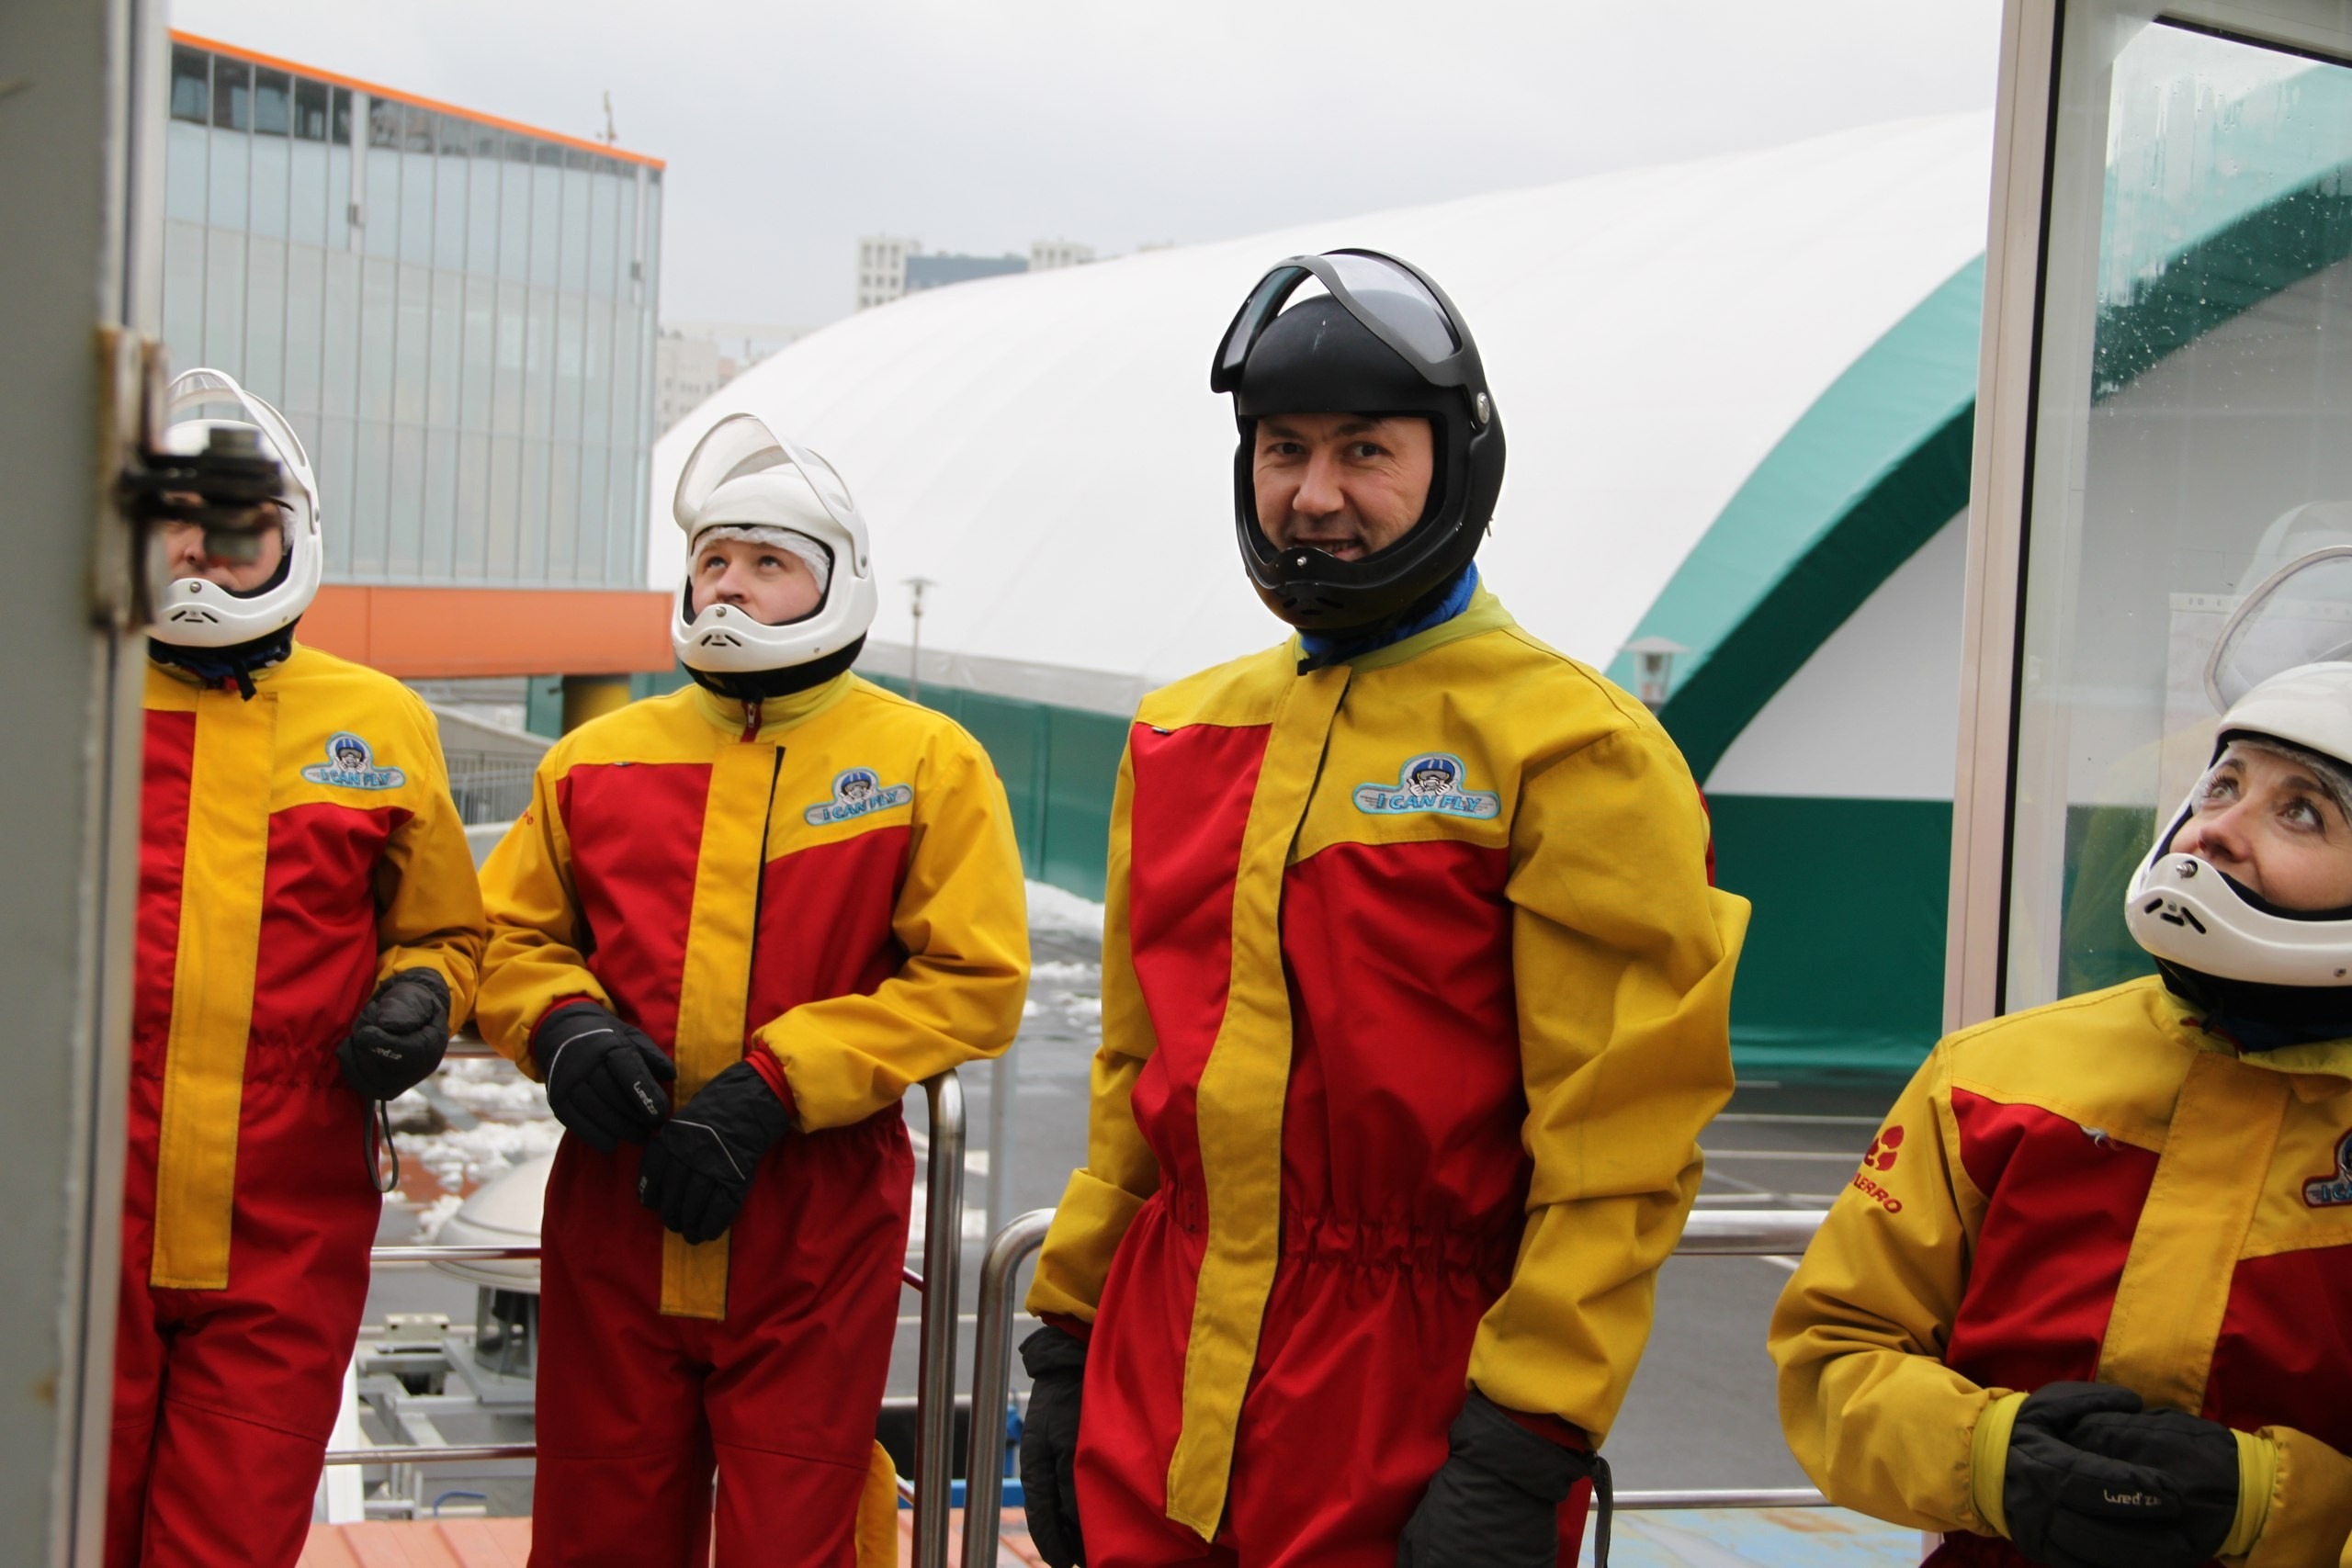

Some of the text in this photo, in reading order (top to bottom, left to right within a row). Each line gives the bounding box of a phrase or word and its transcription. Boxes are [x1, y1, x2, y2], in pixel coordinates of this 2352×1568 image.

[320, 769, 391, 786] I CAN FLY
[822, 790, 899, 820] I CAN FLY
[1376, 793, 1483, 812] I CAN FLY
[1852, 1171, 1904, 1213] LERRO
